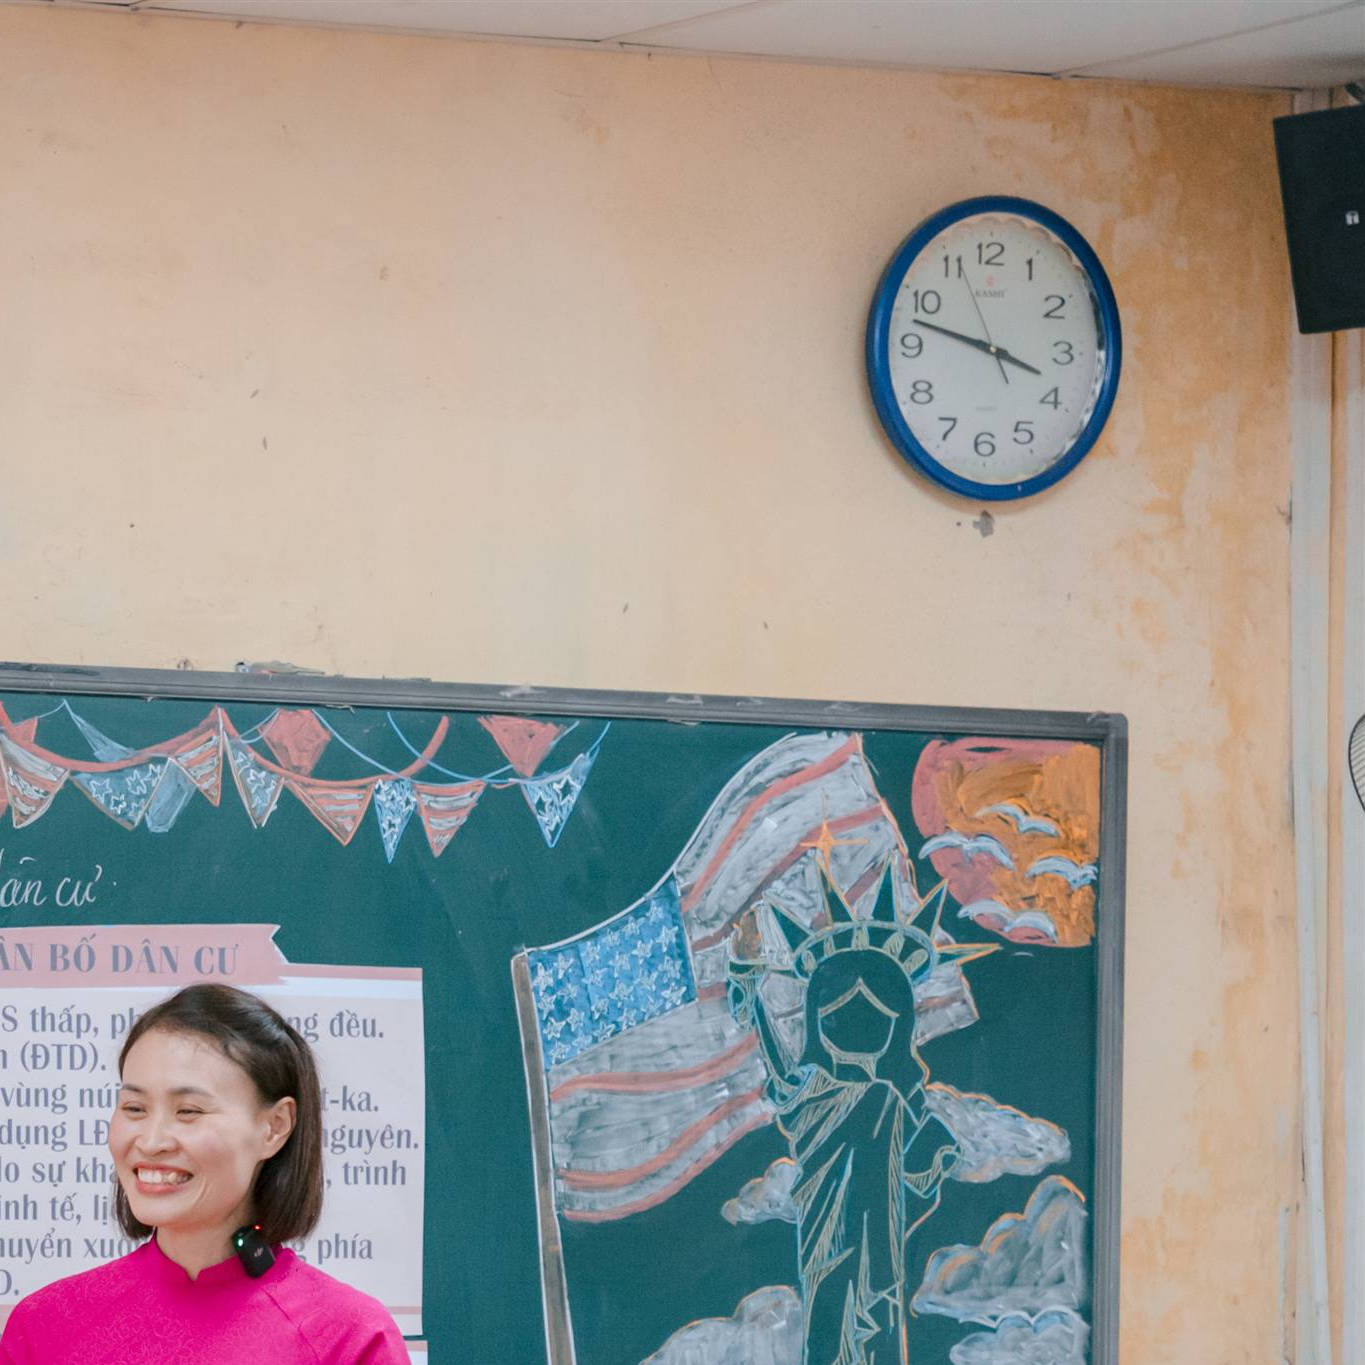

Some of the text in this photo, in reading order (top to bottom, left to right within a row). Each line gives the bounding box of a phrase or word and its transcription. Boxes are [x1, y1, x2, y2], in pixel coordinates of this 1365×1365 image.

[976, 242, 1005, 266] 12
[943, 255, 963, 279] 11
[1025, 258, 1034, 281] 1
[913, 290, 942, 315] 10
[1043, 295, 1066, 319] 2
[900, 333, 924, 358] 9
[1052, 341, 1075, 365] 3
[910, 380, 934, 404] 8
[1039, 386, 1062, 410] 4
[938, 416, 958, 441] 7
[1012, 421, 1034, 444] 5
[973, 432, 996, 457] 6
[49, 934, 96, 973] BỐ
[111, 939, 178, 974] DÂN
[194, 944, 239, 975] CƯ
[30, 1004, 99, 1038] thấp,
[330, 1009, 383, 1038] đều.
[20, 1042, 106, 1072] (ĐTD).
[1, 1083, 68, 1114] vùng
[32, 1163, 66, 1187] sự
[342, 1161, 406, 1185] trình
[49, 1196, 82, 1225] tế,
[318, 1233, 373, 1264] phía
